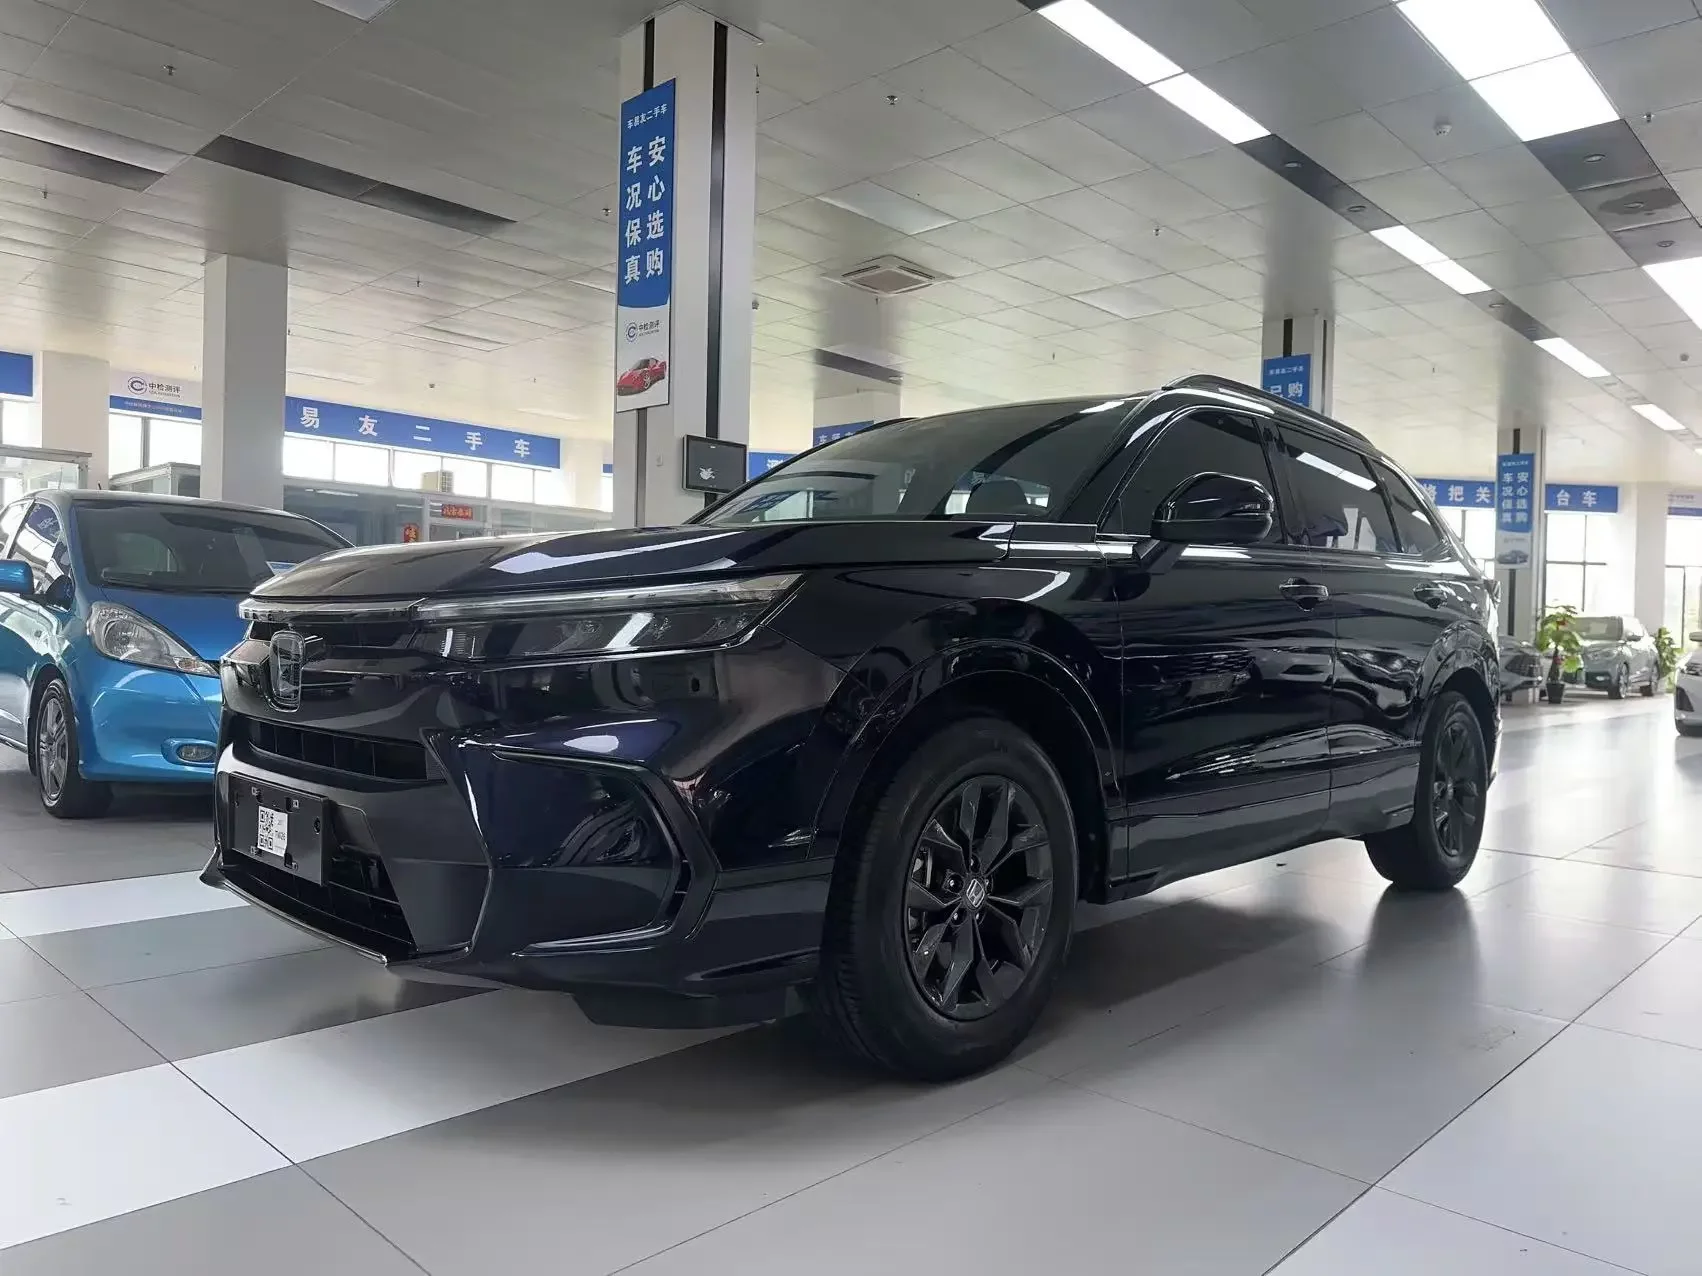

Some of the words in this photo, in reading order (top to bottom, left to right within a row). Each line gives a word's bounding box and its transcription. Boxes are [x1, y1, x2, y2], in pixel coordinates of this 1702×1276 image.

[627, 103, 667, 130] 车易友二手车
[624, 145, 643, 285] 车况保真
[645, 135, 667, 279] 安心选购
[148, 382, 181, 394] 中检测评
[300, 405, 532, 460] 易友二手车
